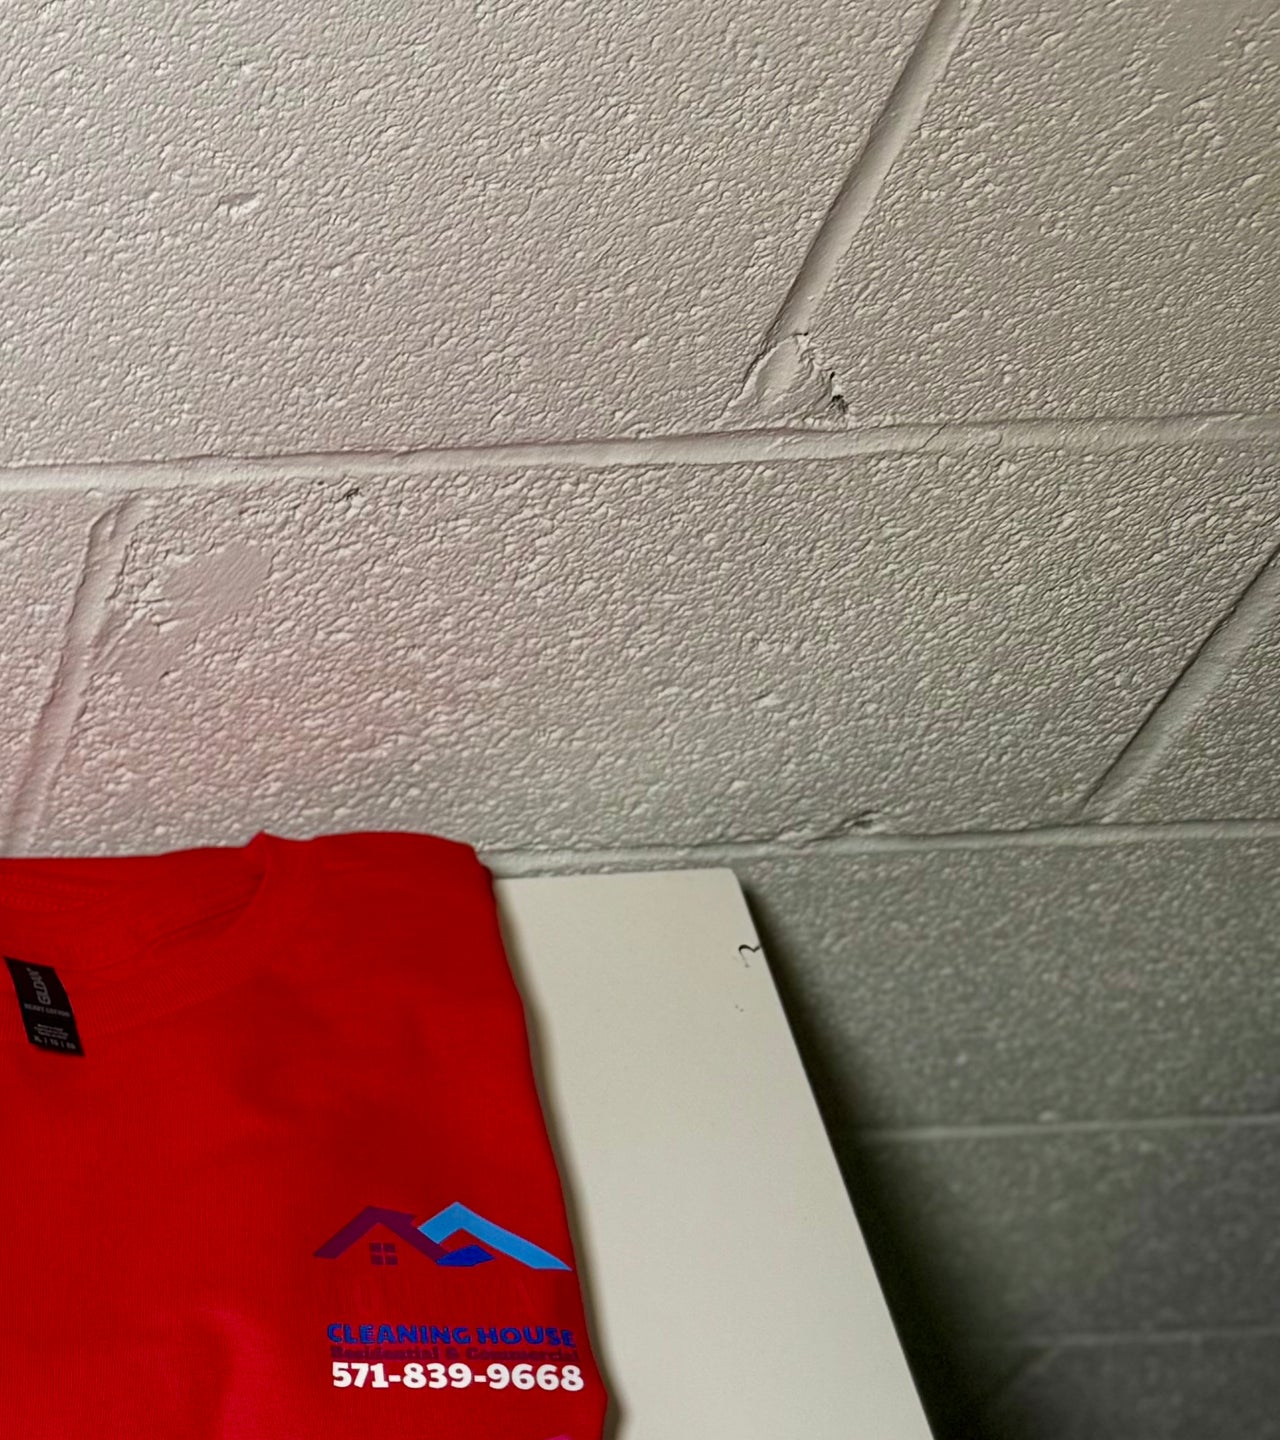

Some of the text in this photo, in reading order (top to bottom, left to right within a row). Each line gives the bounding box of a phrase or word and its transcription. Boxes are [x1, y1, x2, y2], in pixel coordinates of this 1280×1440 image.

[327, 1323, 576, 1348] CLEANING HOUSE
[331, 1361, 584, 1391] 571-839-9668
